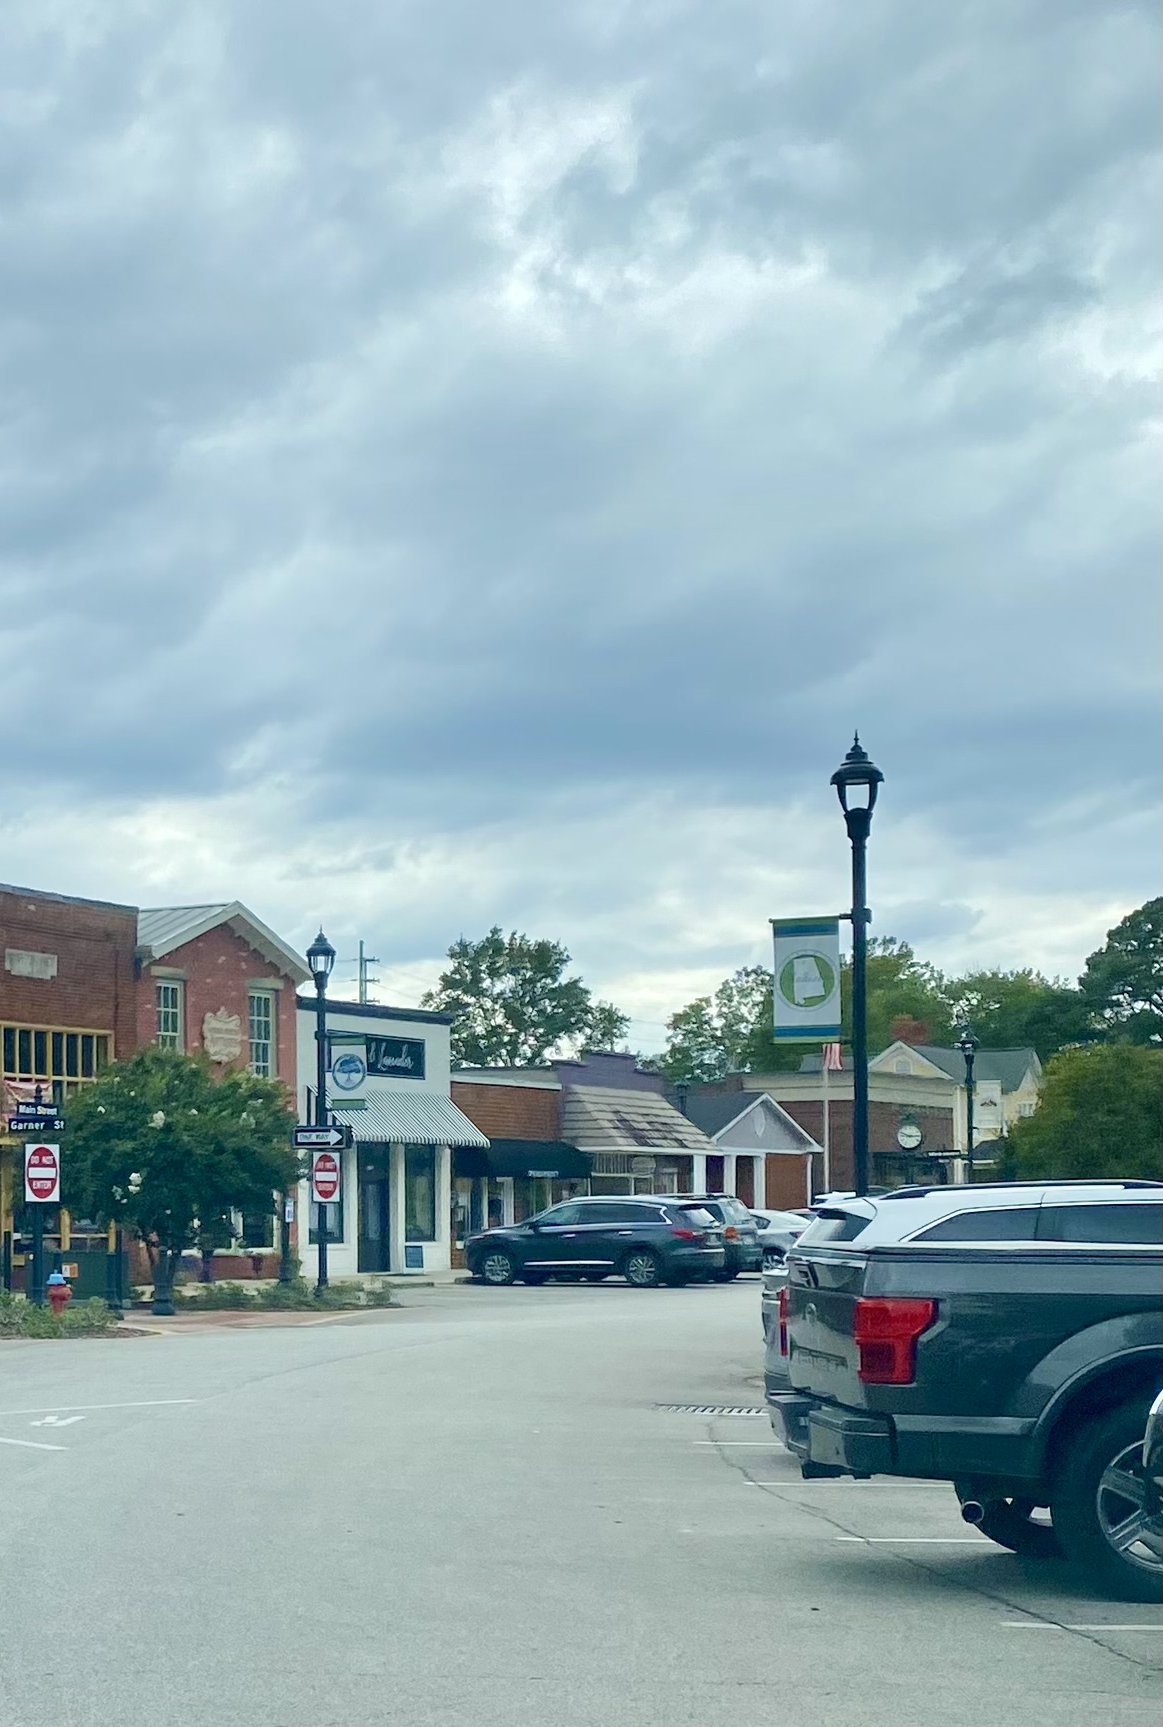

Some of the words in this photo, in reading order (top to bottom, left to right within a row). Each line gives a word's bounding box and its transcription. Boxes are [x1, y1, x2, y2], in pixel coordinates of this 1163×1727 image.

[19, 1105, 36, 1114] Main
[10, 1121, 46, 1130] Garner
[53, 1120, 64, 1130] St
